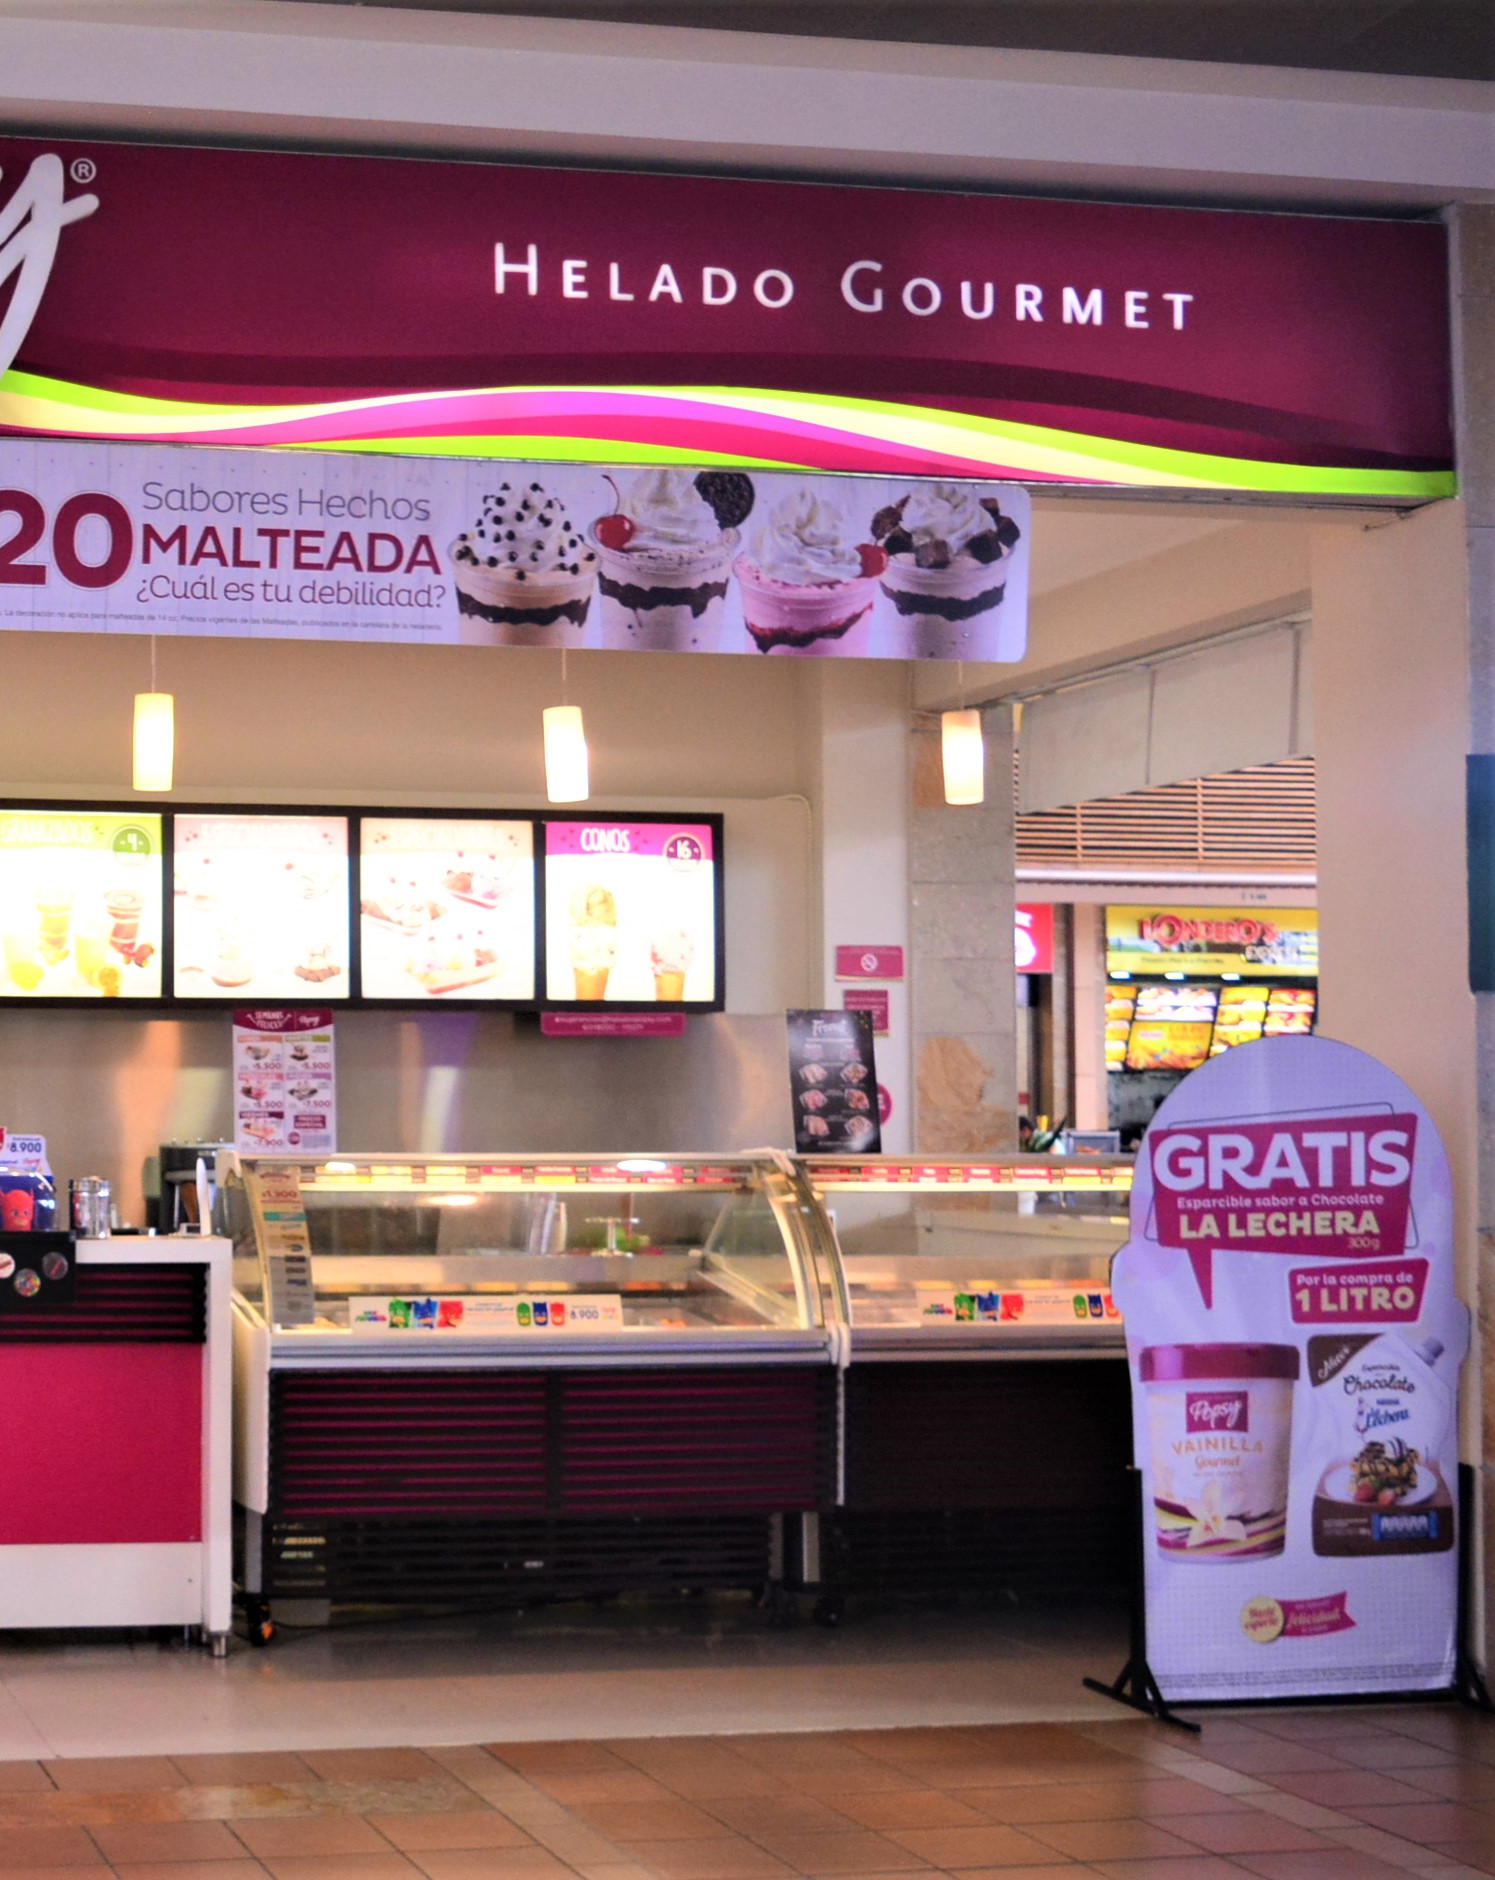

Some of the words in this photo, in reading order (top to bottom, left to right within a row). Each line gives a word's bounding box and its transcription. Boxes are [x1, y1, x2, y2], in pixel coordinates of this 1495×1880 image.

[494, 242, 795, 309] HELADO
[841, 260, 1194, 330] GOURMET
[142, 481, 288, 517] Sabores
[297, 486, 431, 522] Hechos
[142, 524, 443, 576] MALTEADA
[136, 574, 218, 604] ¿Cuál
[223, 583, 252, 603] es
[260, 581, 293, 604] tu
[298, 580, 446, 610] debilidad?
[579, 827, 631, 854] CONOS
[1154, 1130, 1410, 1191] GRATIS
[1177, 1194, 1252, 1210] Esparcible
[1255, 1194, 1295, 1208] sabor
[1299, 1196, 1308, 1207] a
[1311, 1191, 1384, 1206] Chocolate
[1179, 1213, 1220, 1239] LA
[1228, 1210, 1380, 1238] LECHERA
[1296, 1273, 1318, 1286] Por
[1321, 1272, 1337, 1286] la
[1340, 1273, 1393, 1289] compra
[1396, 1271, 1414, 1285] de
[1296, 1287, 1311, 1313] 1
[1320, 1286, 1416, 1313] LITRO
[1189, 1398, 1243, 1429] Popsy
[1171, 1437, 1265, 1456] VAINILLA
